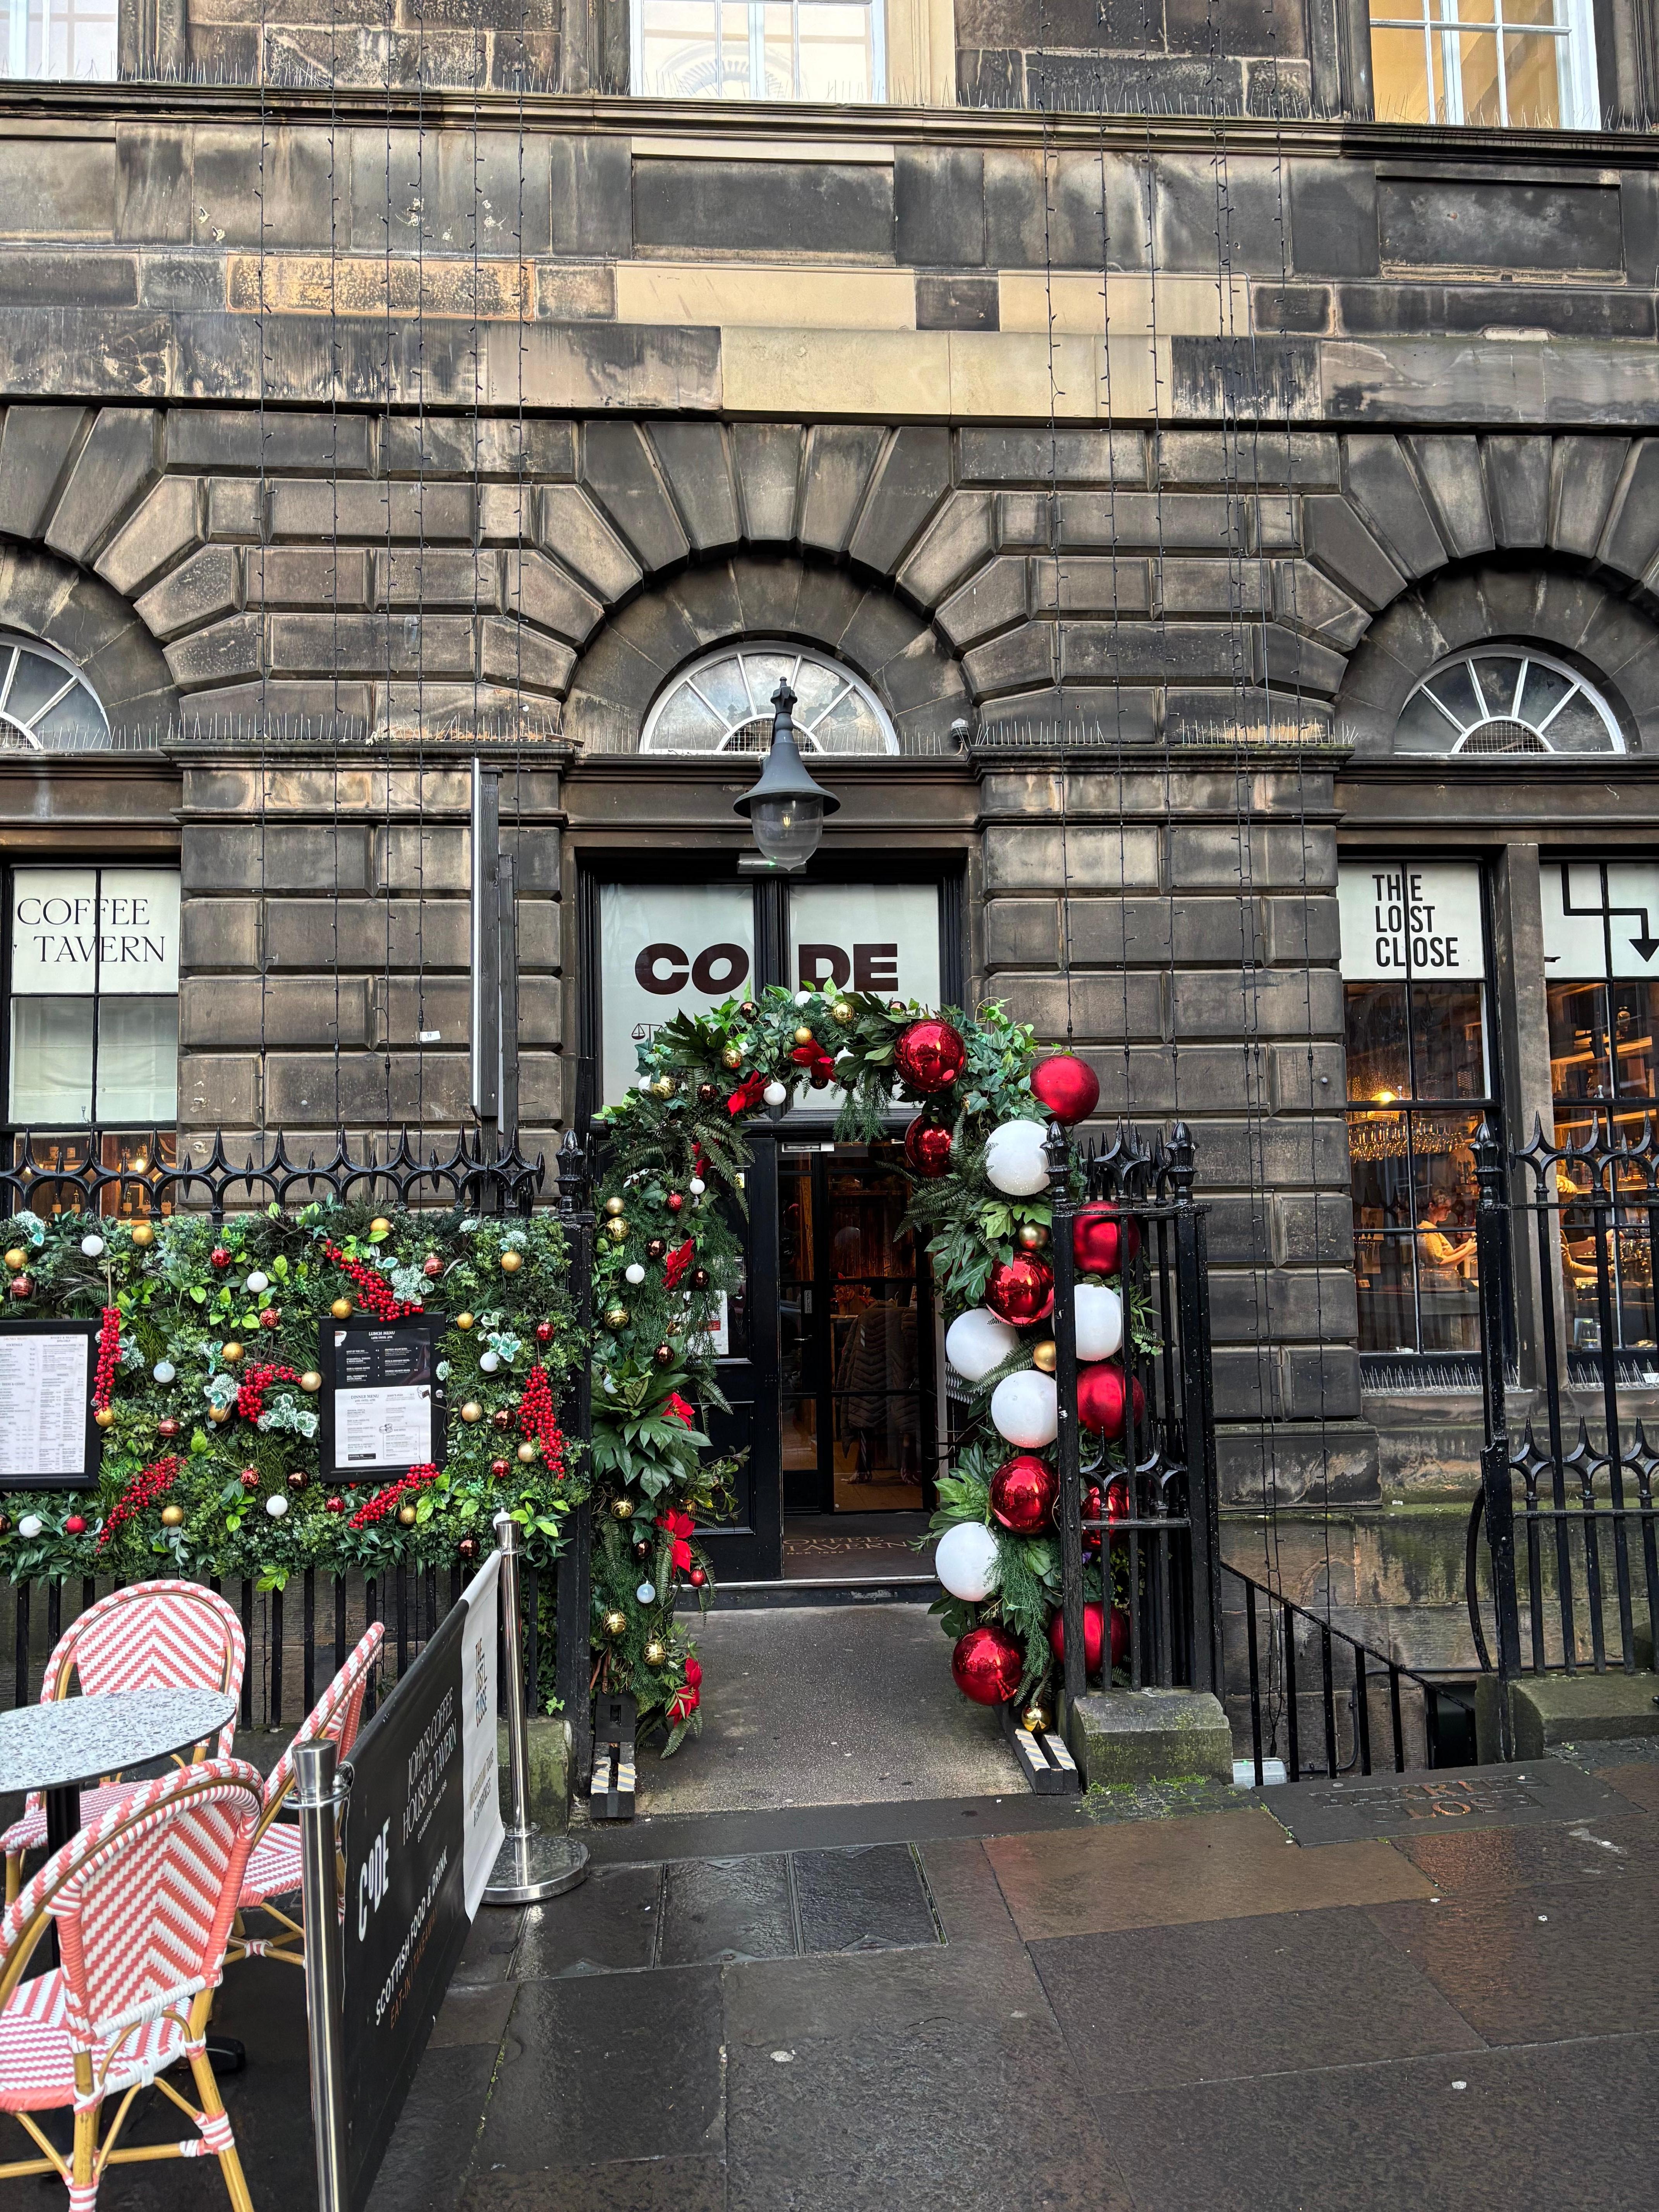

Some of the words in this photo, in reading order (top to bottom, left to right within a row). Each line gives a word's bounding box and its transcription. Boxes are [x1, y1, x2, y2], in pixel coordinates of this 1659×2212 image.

[1372, 874, 1423, 902] THE
[17, 898, 150, 925] COFFEE
[1376, 905, 1435, 933] LOST
[34, 936, 166, 963] TAVERN
[1376, 937, 1459, 967] CLOSE
[783, 1537, 884, 1545] OFFEE
[786, 1541, 907, 1551] TAVERN
[430, 1686, 453, 1747] COFFEE
[476, 1686, 487, 1728] CLOSE
[403, 1776, 427, 1846] HOUSE
[427, 1763, 433, 1795] &
[433, 1718, 457, 1782] TAVERN
[417, 1808, 433, 1843] EDINBURGH
[376, 1934, 410, 2026] SCOTTISH
[410, 1897, 426, 1948] FOOD
[427, 1885, 431, 1907] &
[432, 1846, 447, 1896] DRINK
